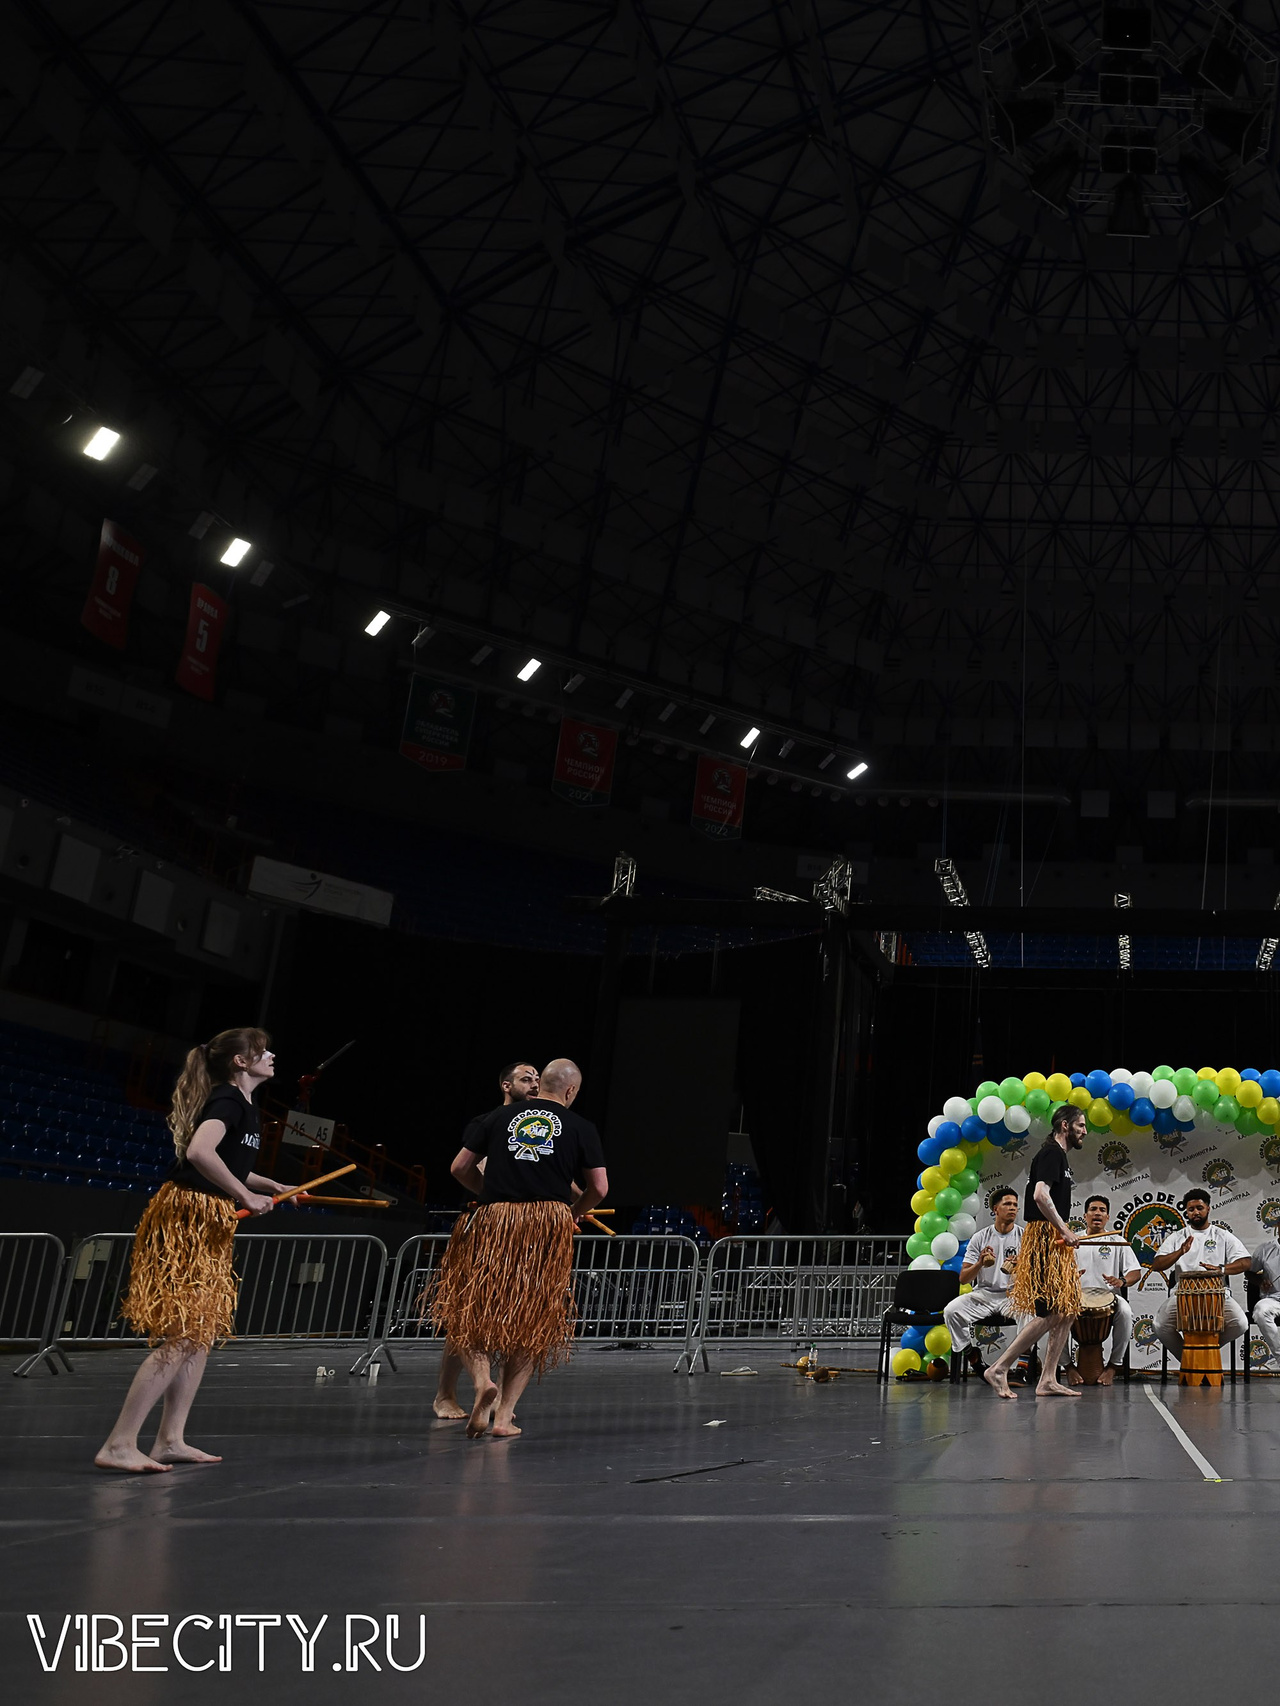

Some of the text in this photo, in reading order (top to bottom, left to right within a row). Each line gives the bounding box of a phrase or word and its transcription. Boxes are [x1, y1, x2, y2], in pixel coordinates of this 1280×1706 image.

[105, 565, 119, 596] 8
[195, 618, 210, 653] 5
[421, 735, 450, 747] РОССИИ
[418, 750, 448, 766] 2019
[564, 757, 605, 774] ЧЕМПИОН
[566, 767, 600, 781] РОССИИ
[568, 787, 593, 802] 2021
[701, 793, 737, 810] ЧЕМПИОН
[703, 803, 733, 817] РОССИИ
[704, 823, 728, 837] 2022
[540, 1109, 552, 1117] DE
[550, 1115, 562, 1136] OURO
[291, 1122, 328, 1141] A6 A5
[1118, 1141, 1130, 1154] OURO
[1179, 1145, 1217, 1164] КАЛИНИНГРАД
[1221, 1158, 1234, 1171] OURO
[1111, 1173, 1150, 1192] КАЛИНИНГРАД
[1211, 1191, 1250, 1210] КАЛИНИНГРАД
[1113, 1192, 1153, 1231] ORDÃO
[1157, 1192, 1175, 1205] DE
[1220, 1220, 1233, 1233] OURO
